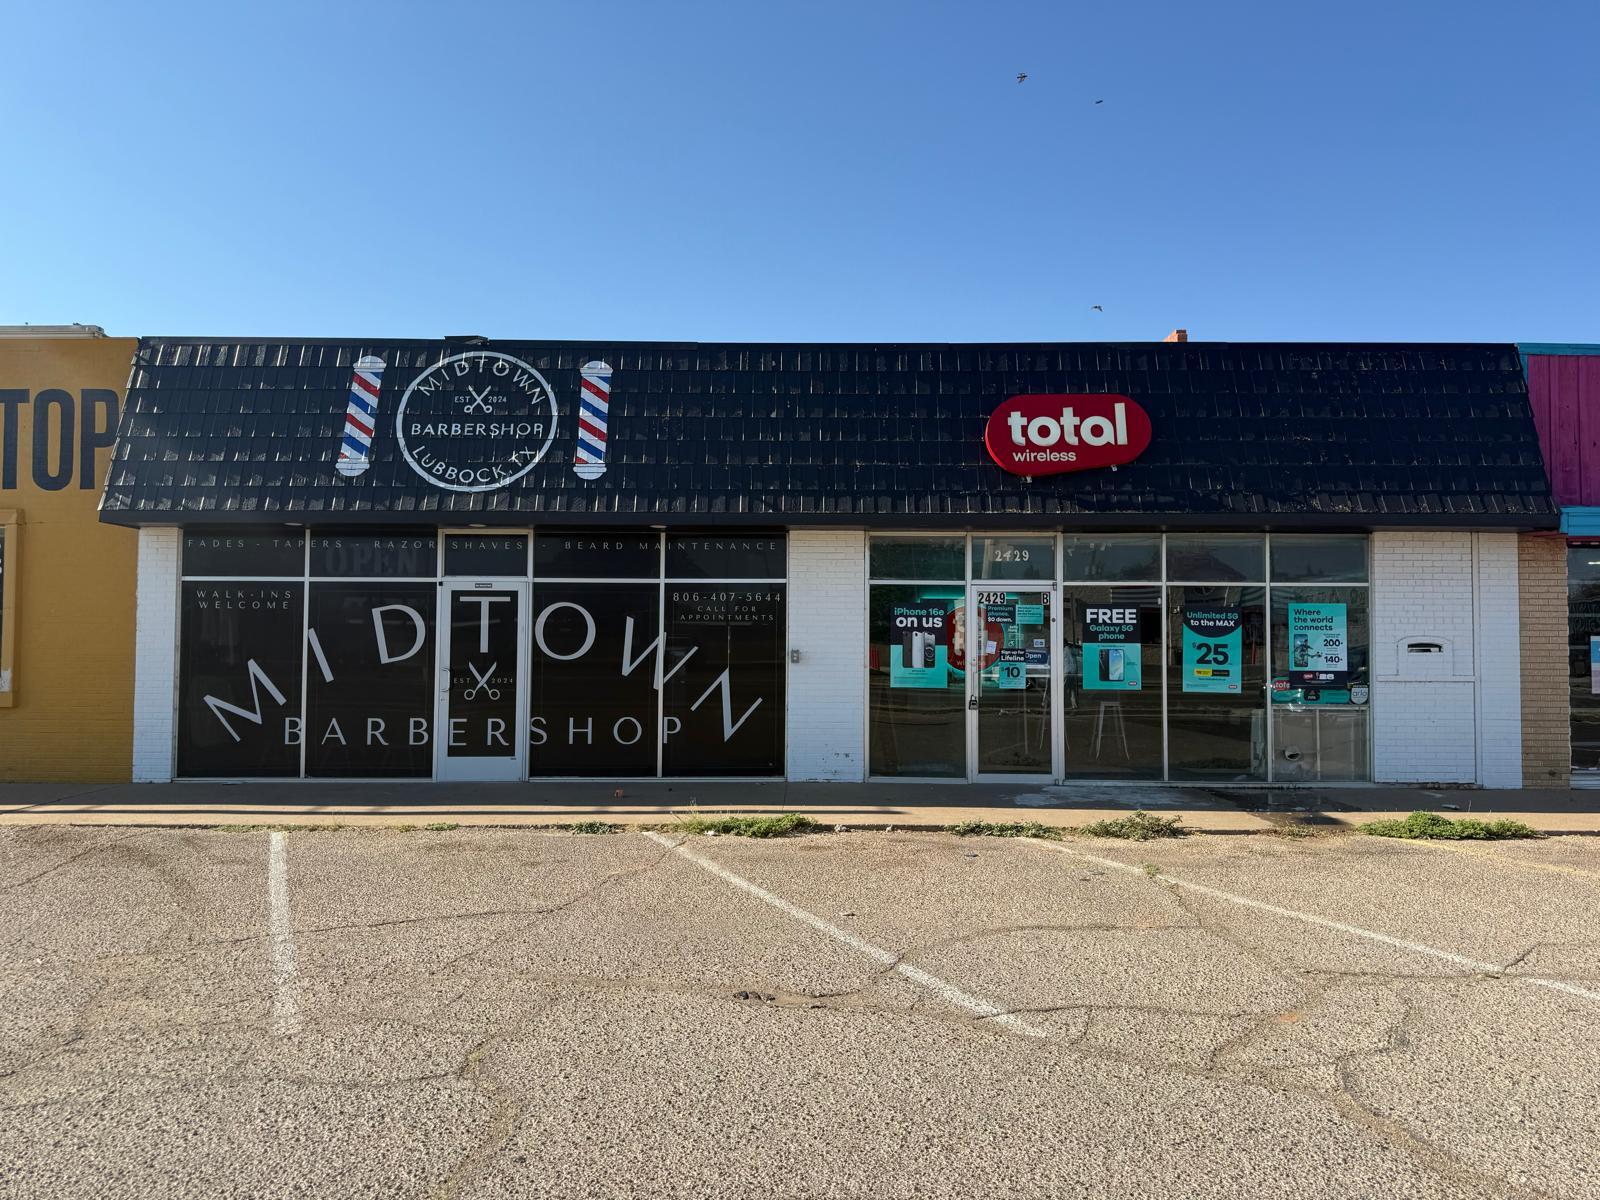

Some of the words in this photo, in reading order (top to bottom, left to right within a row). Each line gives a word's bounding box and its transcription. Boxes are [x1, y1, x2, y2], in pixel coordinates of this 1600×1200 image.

[418, 359, 546, 405] MIDTOWN
[454, 395, 470, 403] EST
[488, 395, 507, 403] 2024
[411, 423, 544, 436] BARBERSHOP
[1007, 402, 1128, 447] total
[0, 388, 119, 491] TOP
[508, 446, 535, 467] TX
[1012, 449, 1077, 462] wireless
[187, 539, 245, 548] FADES
[273, 539, 342, 549] TAPERS
[373, 540, 435, 549] RAZOR
[451, 541, 523, 550] SHAVES
[564, 541, 624, 551] BEARD
[638, 541, 776, 551] MAINTENANCE
[995, 551, 1029, 562] 2429
[196, 589, 292, 599] WALK-INS
[672, 592, 782, 603] 806-407-5644
[978, 592, 1006, 604] 2429
[1042, 593, 1049, 604] B
[198, 600, 290, 610] WELCOME
[696, 605, 727, 613] CALL
[734, 605, 757, 613] FOR
[894, 607, 927, 616] iPhone
[929, 607, 945, 616] 16e
[1086, 608, 1137, 624] FREE
[1186, 611, 1226, 620] Unlimited
[1227, 612, 1239, 620] 5G
[1293, 608, 1322, 616] Where
[679, 613, 775, 622] APPOINTMENTS
[895, 616, 918, 628] on
[922, 616, 943, 628] us
[1293, 616, 1308, 624] the
[1309, 616, 1334, 624] world
[1200, 619, 1214, 627] the
[1293, 624, 1334, 632] connects
[1089, 624, 1120, 633] Galaxy
[1098, 633, 1125, 641] phone
[1025, 652, 1042, 660] Open
[203, 596, 763, 744] MIDTOWN
[284, 716, 682, 746] BARBERSHOP
